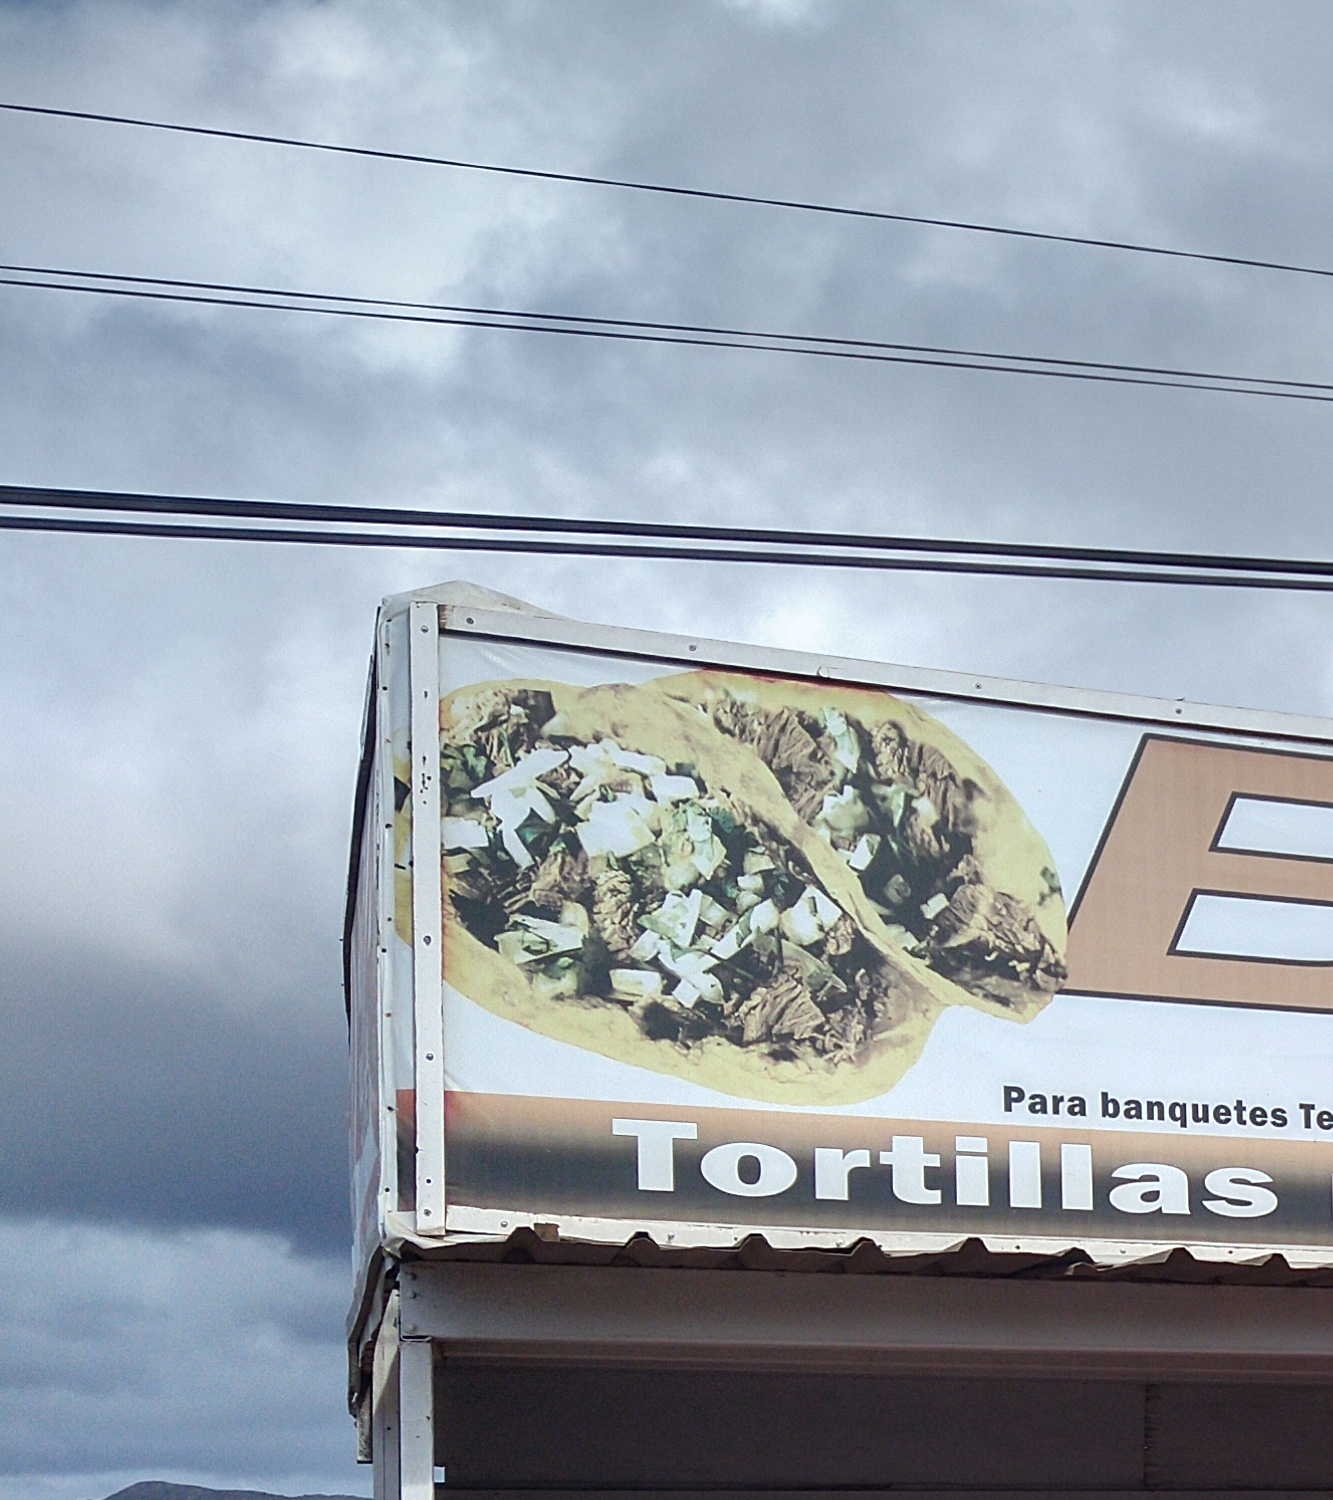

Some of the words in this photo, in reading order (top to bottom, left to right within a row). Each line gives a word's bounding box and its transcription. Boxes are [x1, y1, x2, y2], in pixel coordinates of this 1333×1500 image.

[1002, 1085, 1087, 1119] Para
[1100, 1091, 1289, 1131] banquetes
[611, 1119, 1279, 1219] Tortillas
